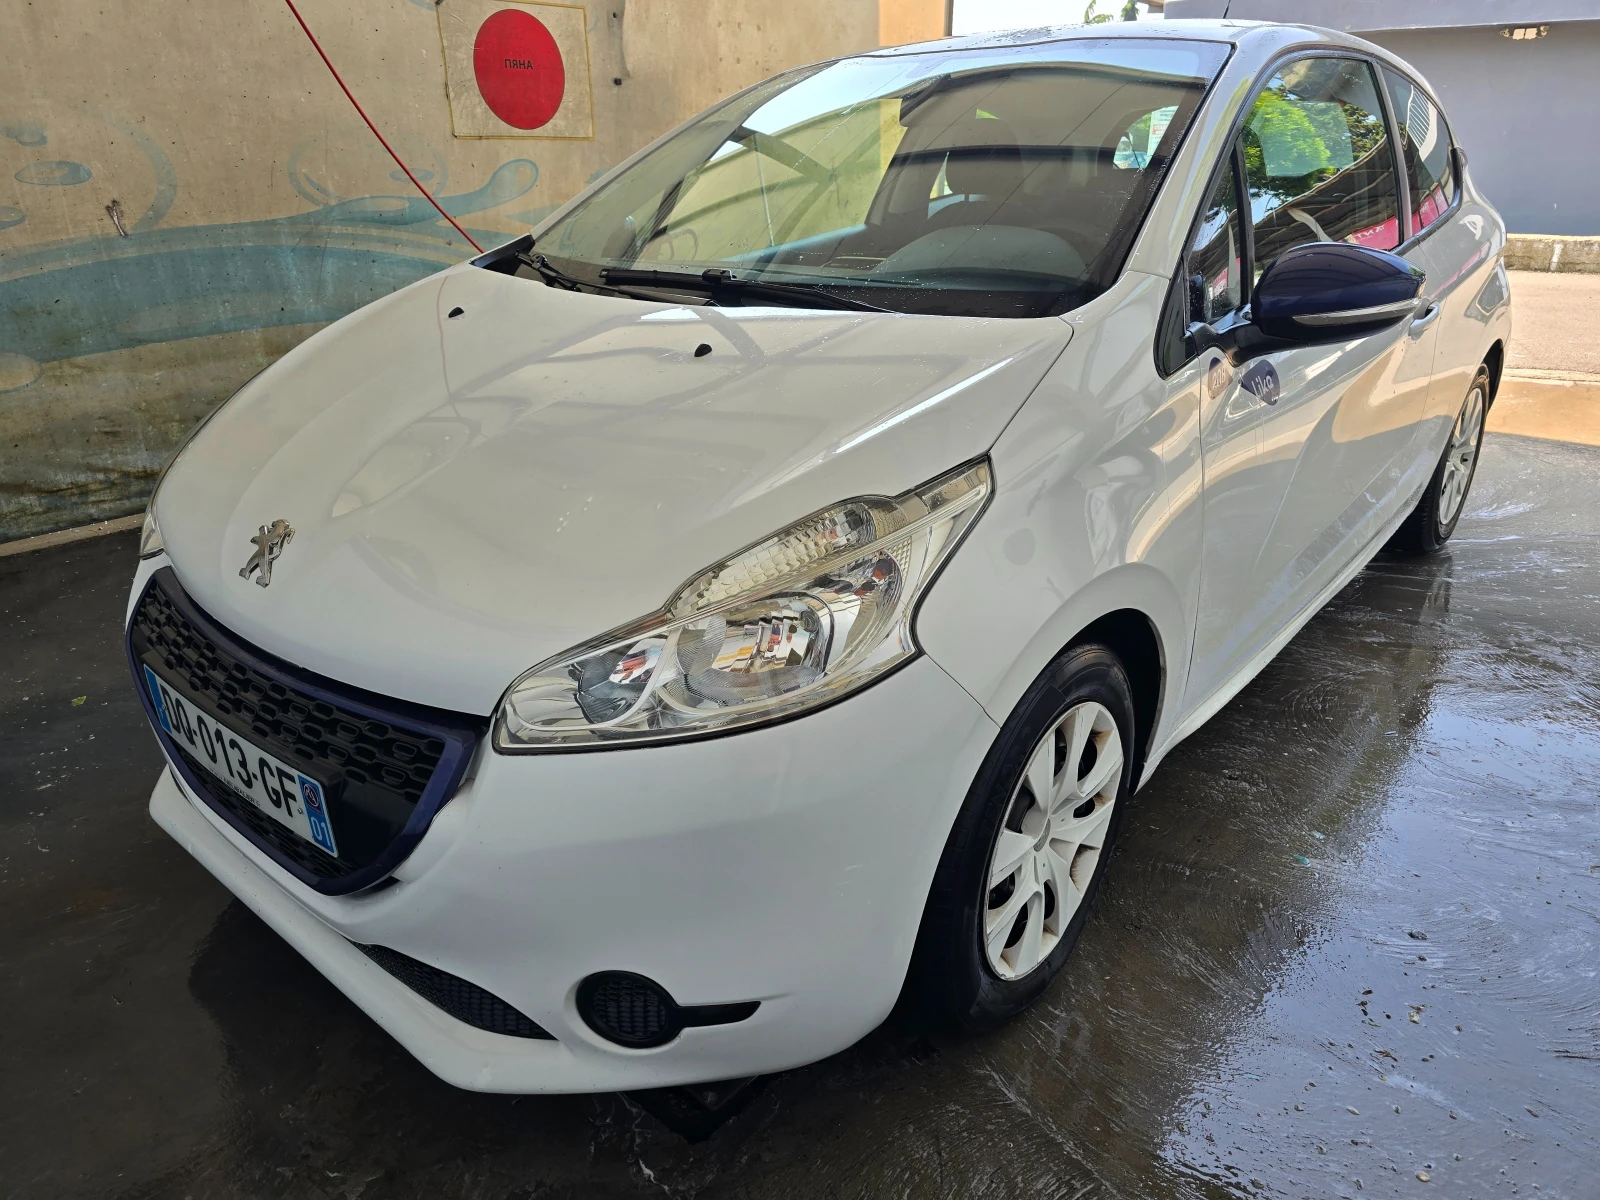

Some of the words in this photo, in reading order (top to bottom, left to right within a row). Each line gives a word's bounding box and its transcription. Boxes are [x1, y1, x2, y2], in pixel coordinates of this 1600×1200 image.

[504, 58, 534, 70] ПЯНА
[160, 683, 298, 818] DQ-013-GF
[310, 816, 331, 847] 01
